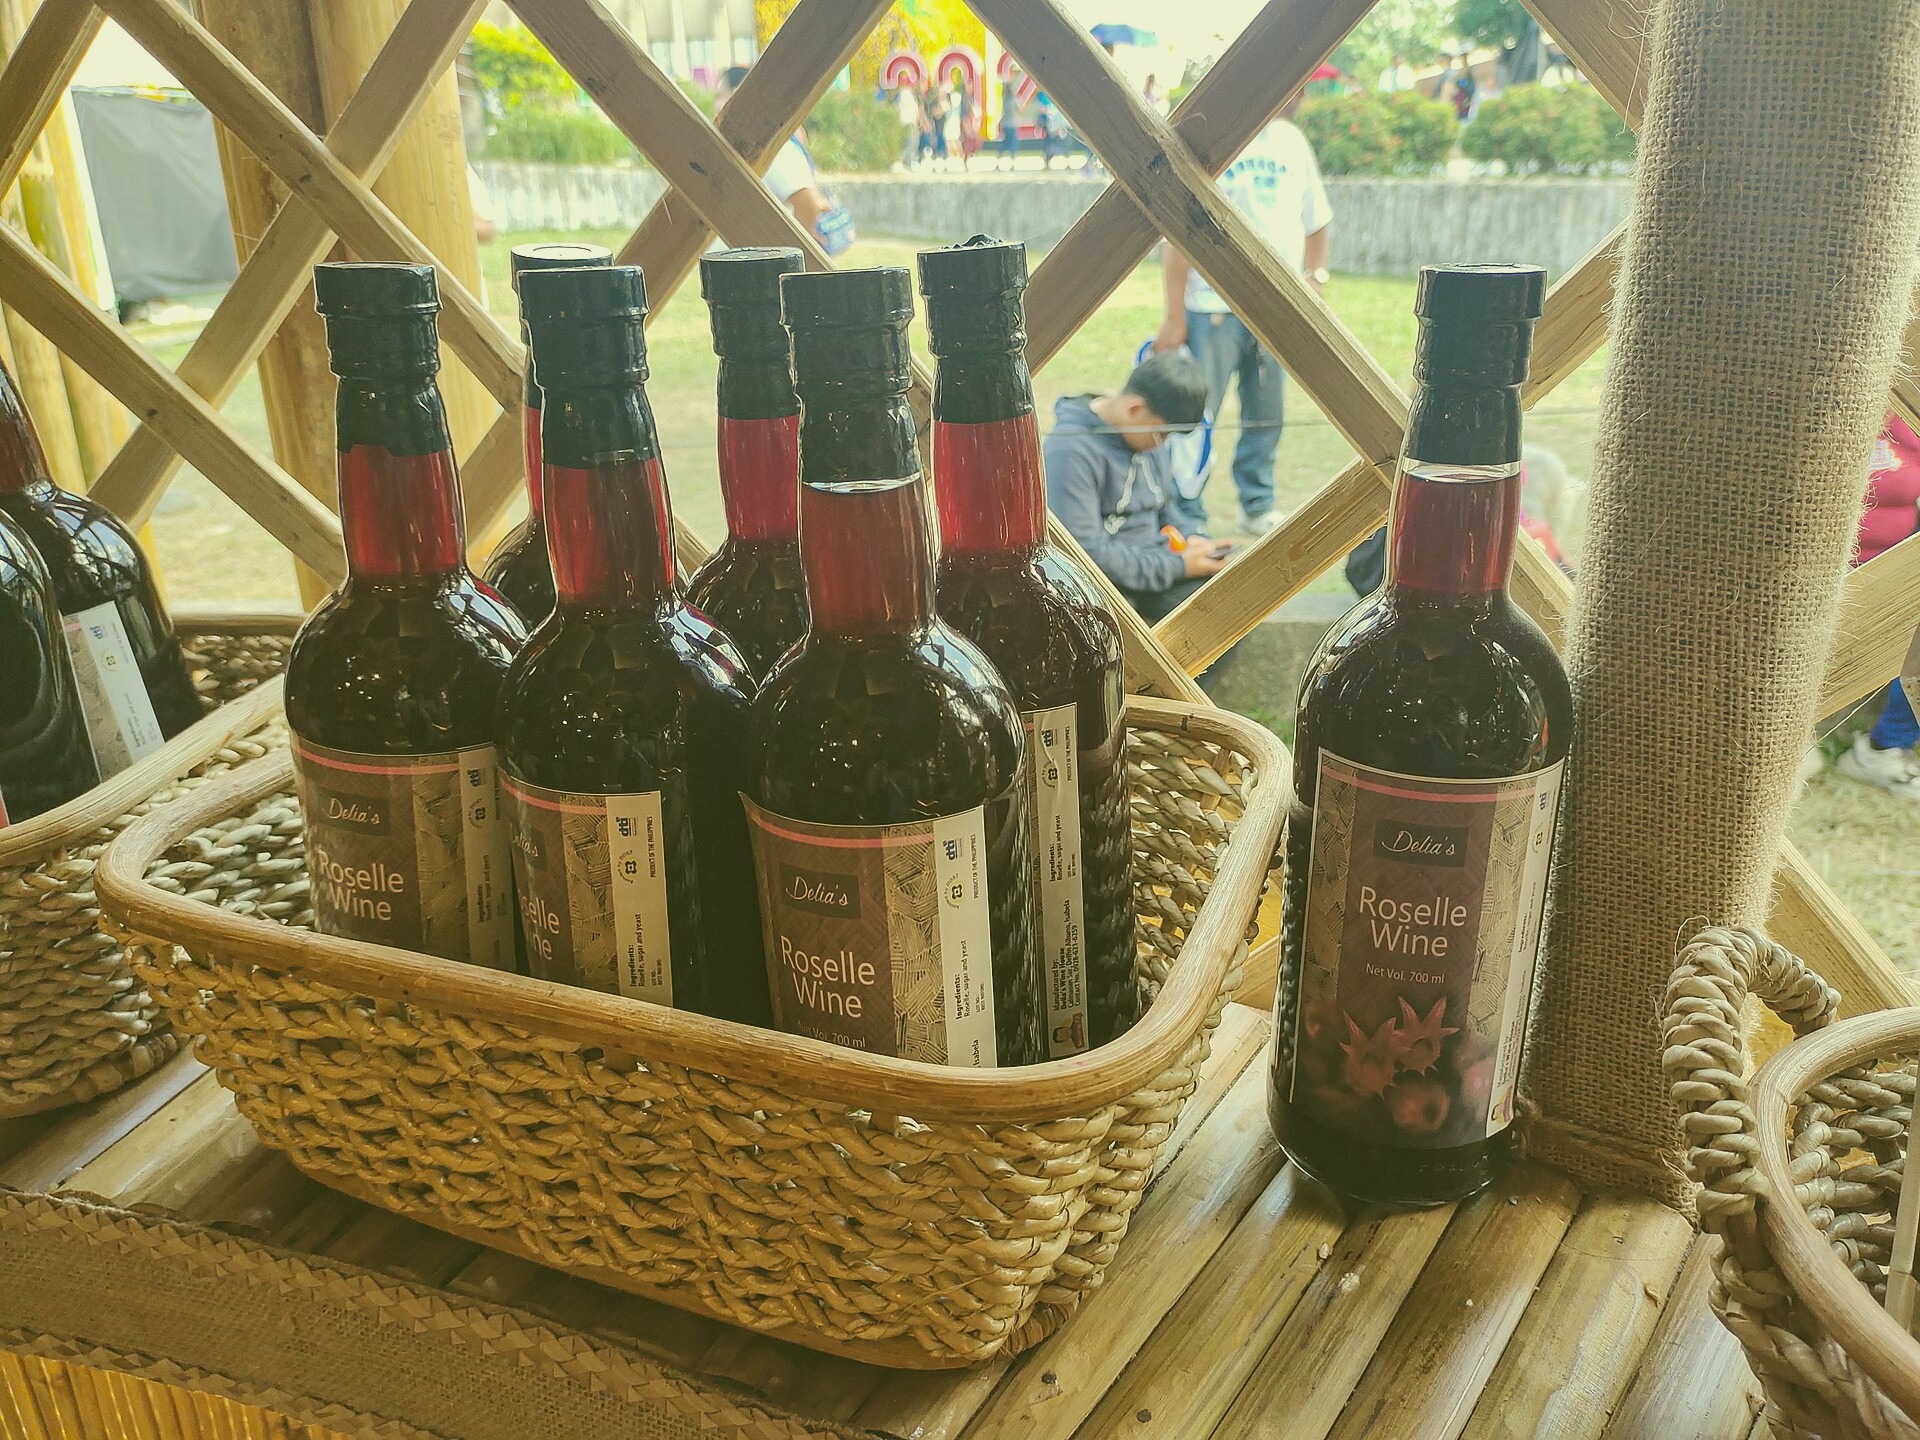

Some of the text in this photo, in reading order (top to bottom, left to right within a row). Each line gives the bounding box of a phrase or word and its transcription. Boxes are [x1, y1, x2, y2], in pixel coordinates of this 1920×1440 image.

[328, 797, 381, 825] Delia's
[615, 816, 629, 837] dti
[943, 840, 956, 861] dti
[1381, 830, 1455, 855] Delia's
[317, 849, 404, 893] Roselle
[328, 881, 392, 921] Wine
[785, 876, 848, 906] Delia's
[1359, 885, 1467, 926] Roselle
[634, 913, 643, 931] yeast
[635, 932, 643, 944] and
[960, 939, 968, 957] yeast
[1370, 919, 1448, 957] Wine
[627, 944, 637, 987] Ingredients:
[780, 935, 875, 985] Roselle
[1366, 962, 1445, 984] Net Vol. 700 ml
[792, 972, 862, 1018] Wine
[954, 974, 963, 1020] Ingredients:
[963, 991, 971, 1017] Roselle,
[832, 1032, 850, 1046] 700
[852, 1036, 866, 1048] ml
[971, 1039, 980, 1066] Isabela
